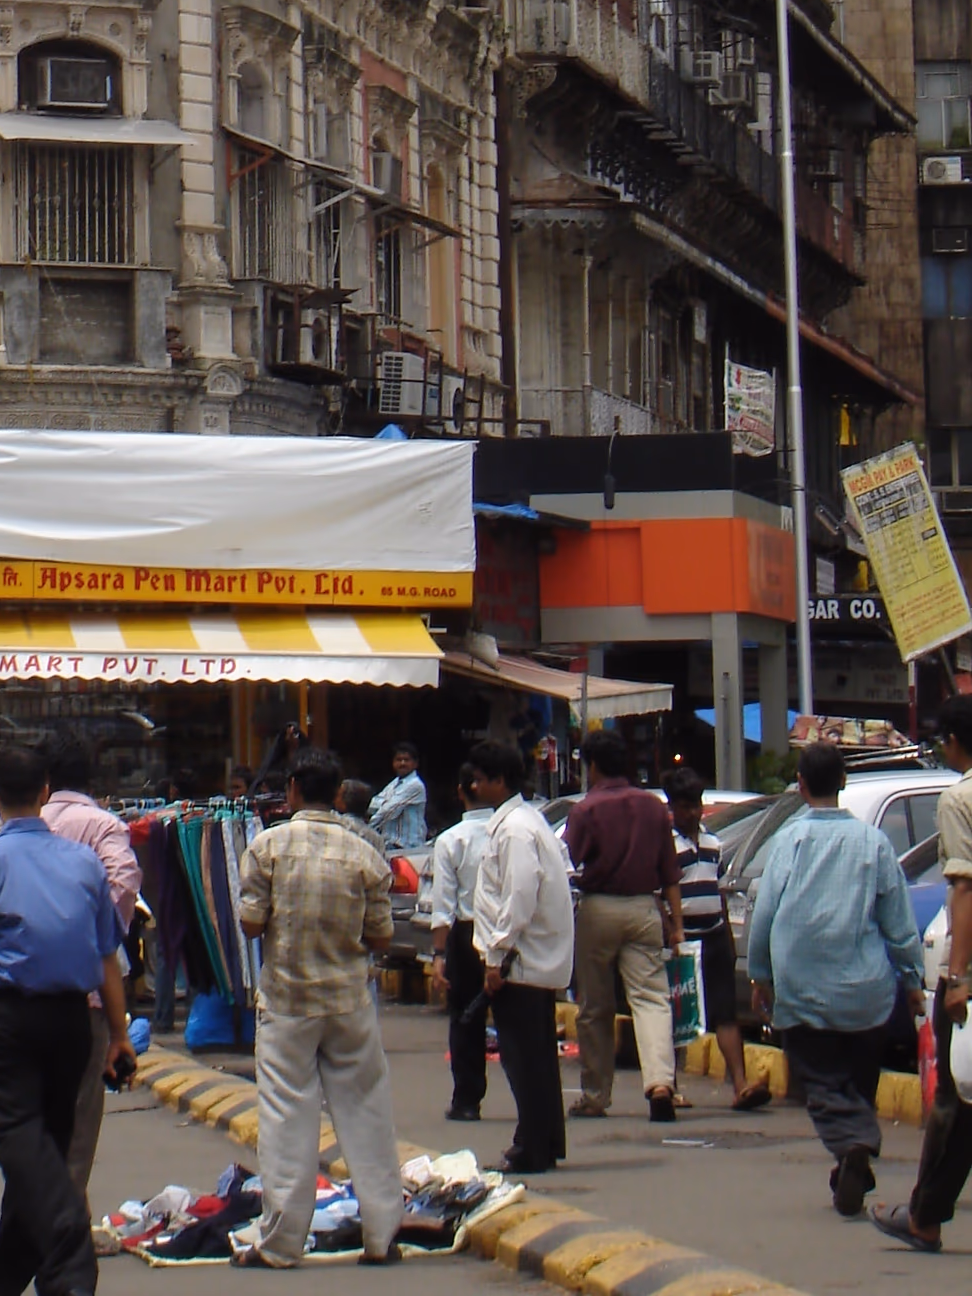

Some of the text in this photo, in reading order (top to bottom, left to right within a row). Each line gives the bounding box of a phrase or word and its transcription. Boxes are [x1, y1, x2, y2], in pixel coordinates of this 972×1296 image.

[894, 456, 914, 473] PARK
[37, 567, 124, 592] Apsara
[133, 567, 176, 592] Pen
[185, 568, 247, 592] Mart
[397, 587, 421, 597] M.G.
[423, 587, 457, 598] ROAD
[849, 599, 881, 619] CO.
[102, 657, 166, 676] PVT.
